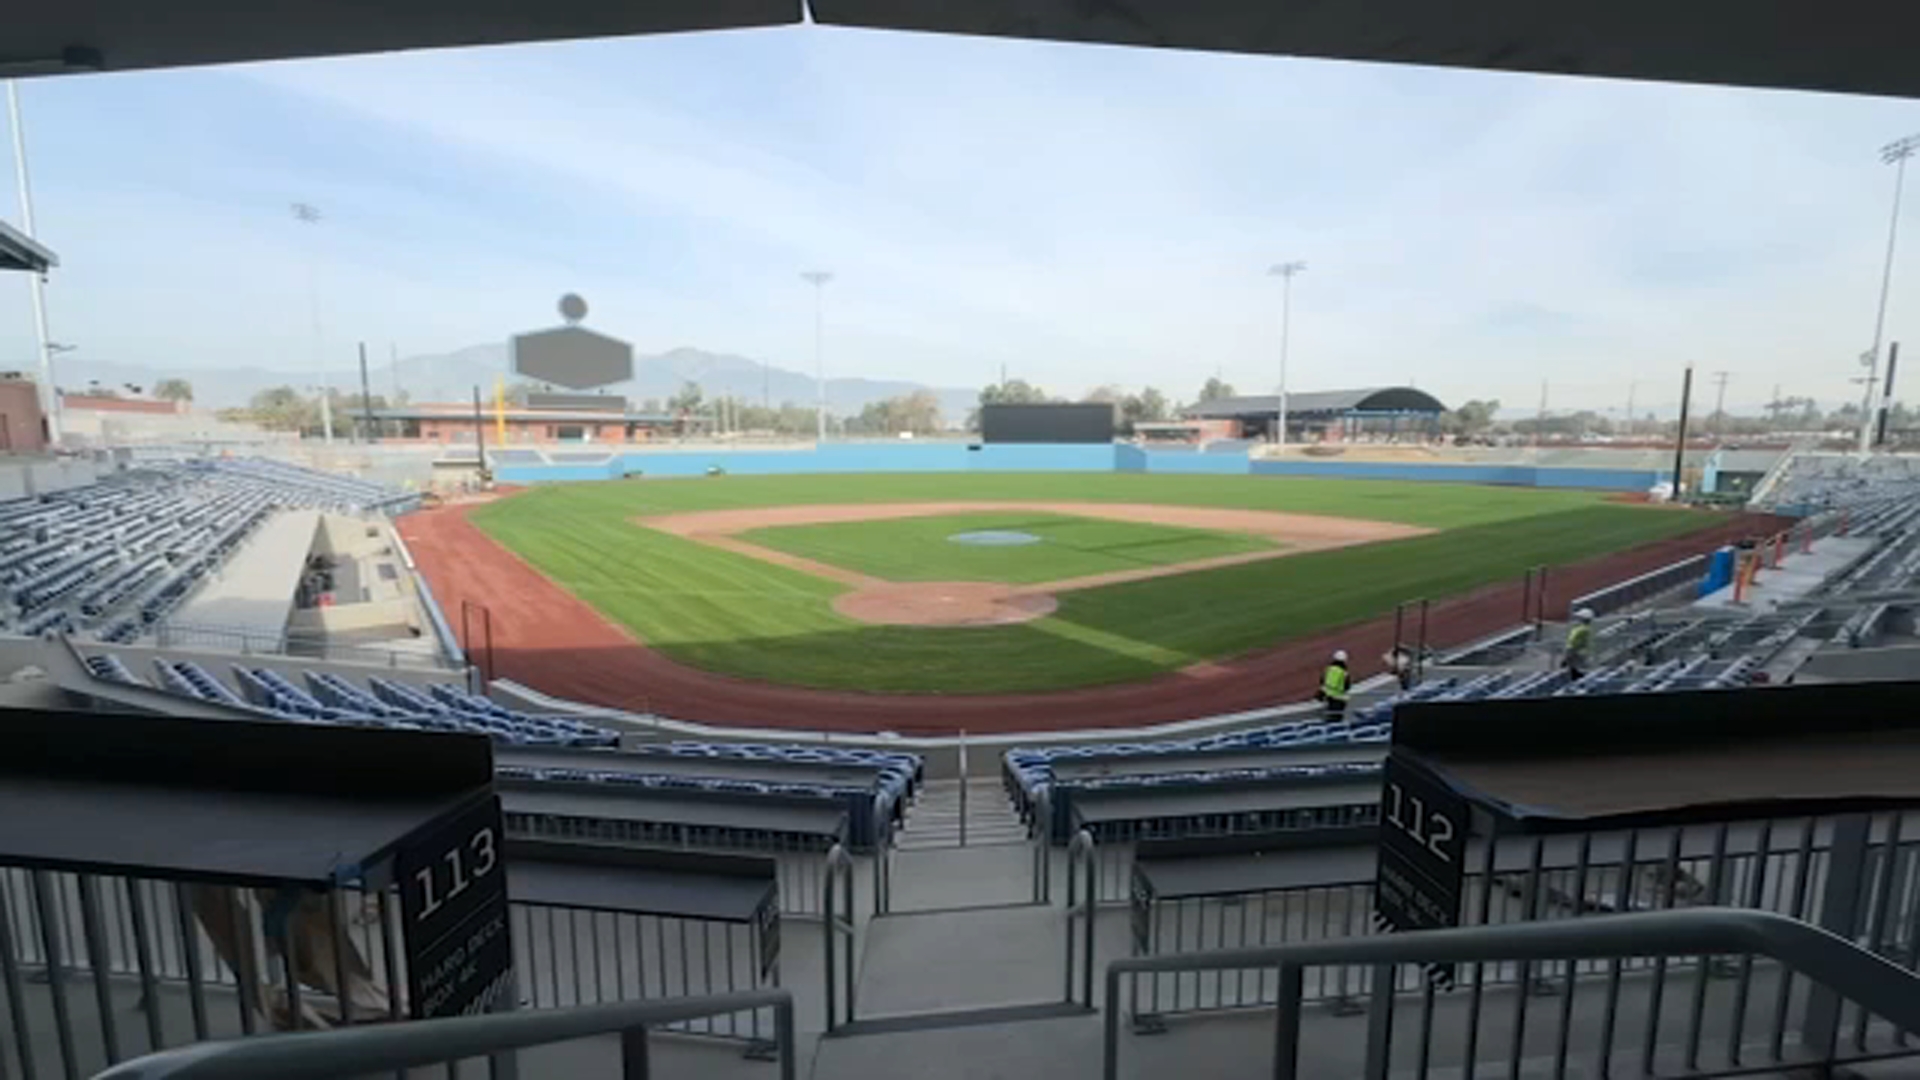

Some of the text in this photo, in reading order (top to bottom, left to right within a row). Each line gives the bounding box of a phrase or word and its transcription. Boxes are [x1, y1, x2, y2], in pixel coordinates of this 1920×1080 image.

[1387, 783, 1454, 862] 112
[415, 826, 497, 921] 113
[420, 914, 505, 994] HARD DECK
